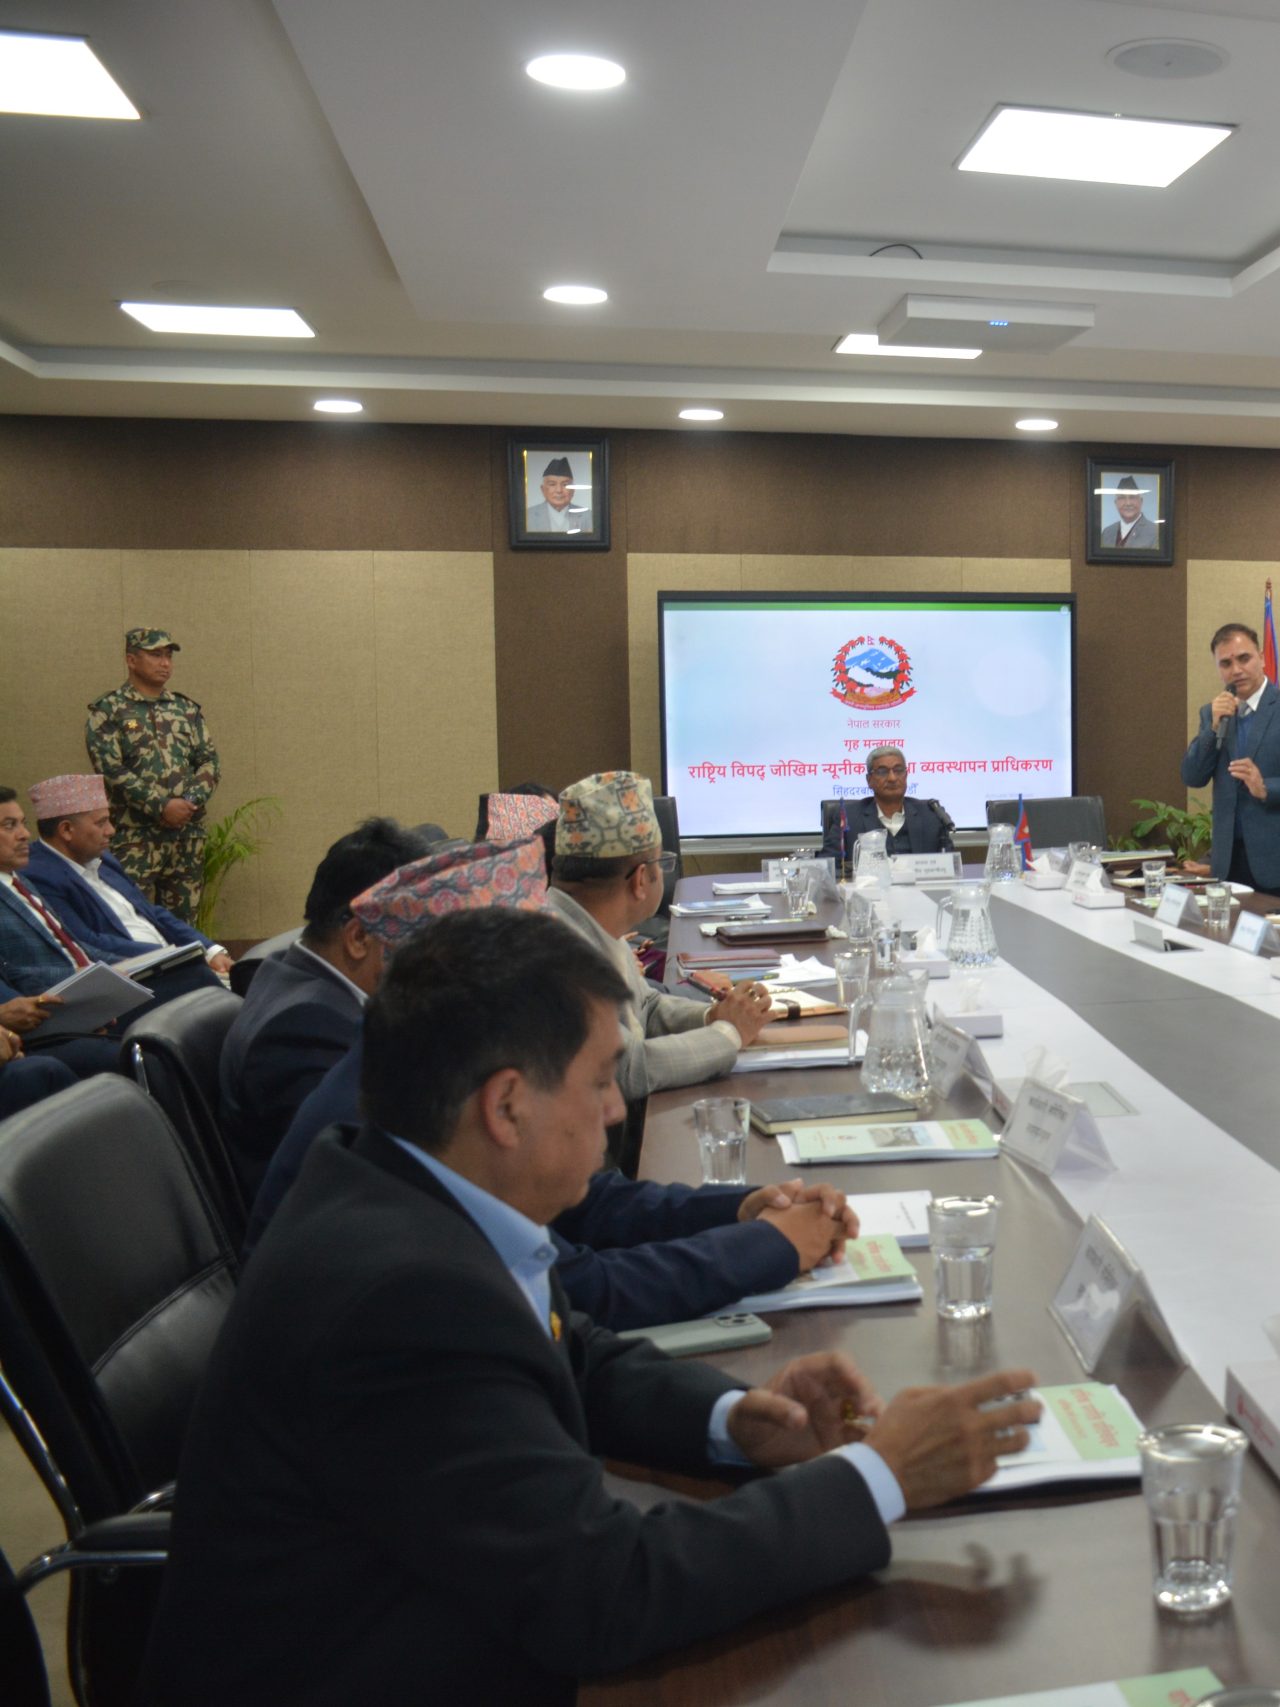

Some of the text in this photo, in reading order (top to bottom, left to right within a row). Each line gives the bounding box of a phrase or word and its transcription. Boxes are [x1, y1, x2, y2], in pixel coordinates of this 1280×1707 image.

[847, 717, 902, 729] नेपाल सरकार
[843, 739, 860, 752] गृह
[688, 761, 727, 783] राष्ट्रिय
[731, 761, 766, 781] विपद्
[769, 759, 818, 777] जोखिम
[821, 758, 866, 780] न्यूनीक
[920, 759, 988, 774] व्यवस्थापन
[991, 756, 1053, 774] प्राधिकरण
